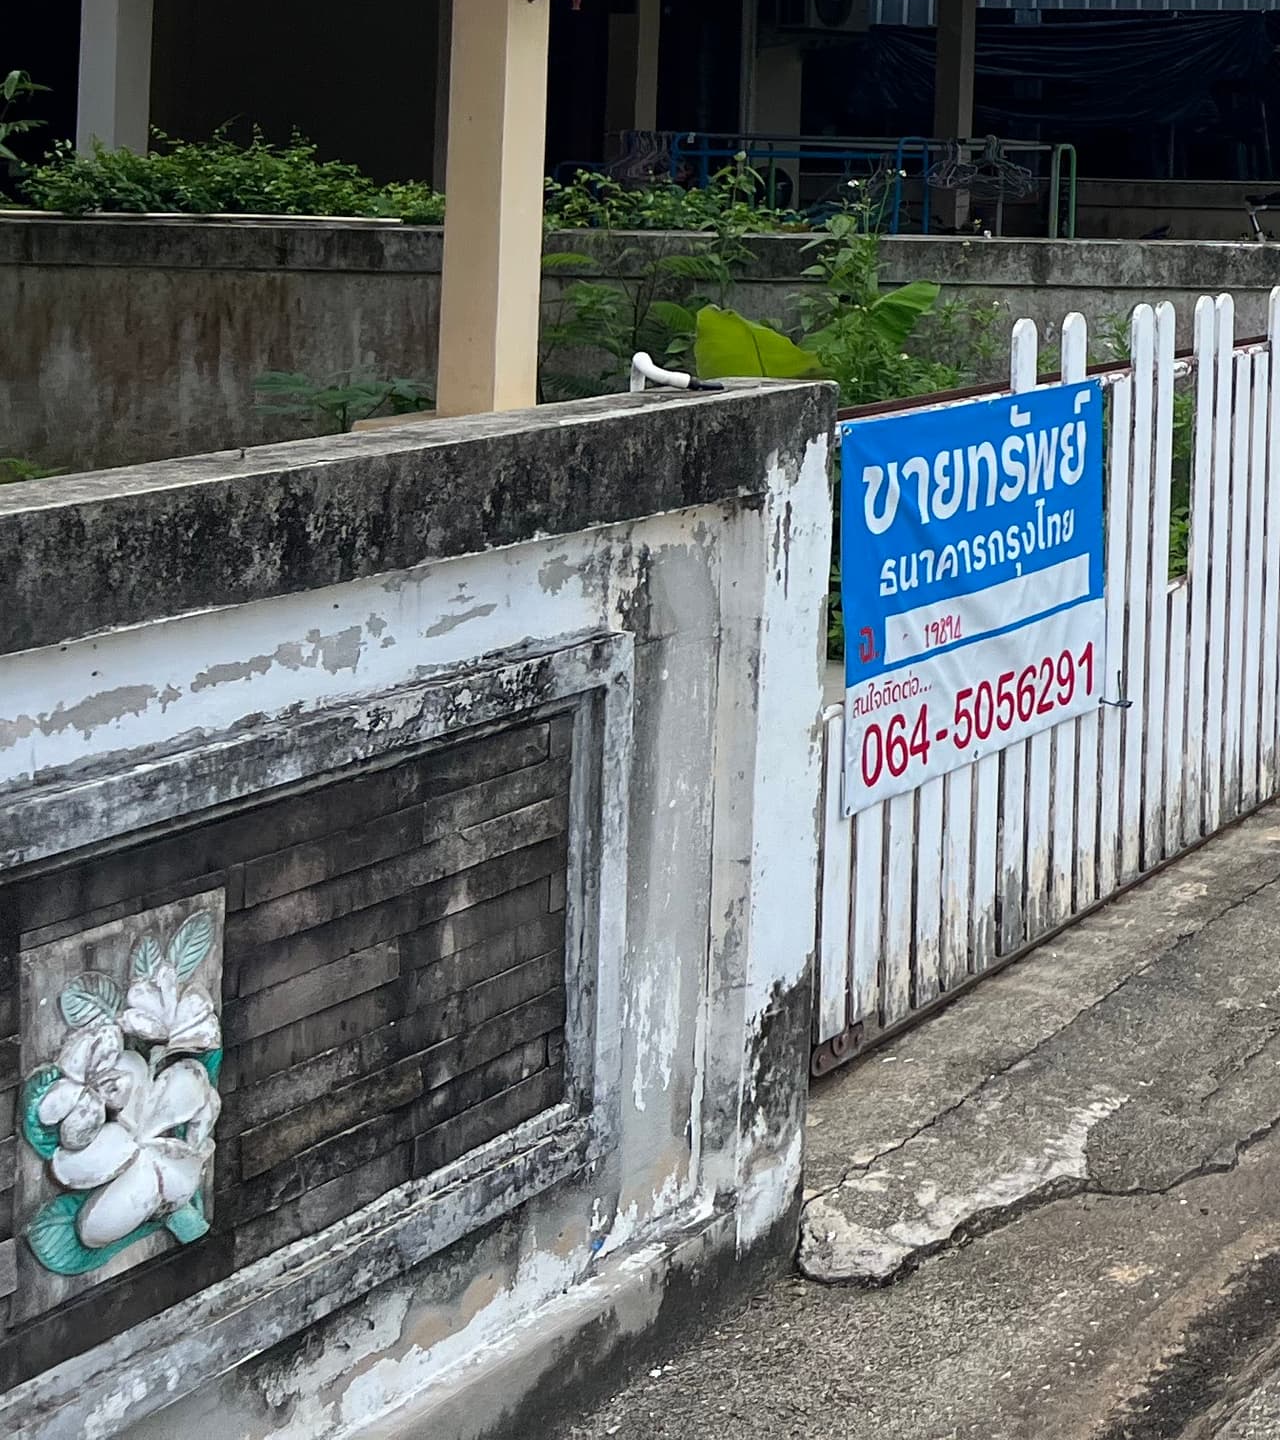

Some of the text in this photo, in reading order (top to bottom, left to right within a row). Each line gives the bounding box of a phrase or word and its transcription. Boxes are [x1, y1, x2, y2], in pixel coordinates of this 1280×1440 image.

[862, 389, 1091, 535] ขายทรัพย์
[879, 498, 1075, 597] ธนาคารกรุงไทย
[860, 641, 1094, 788] 064-5056291
